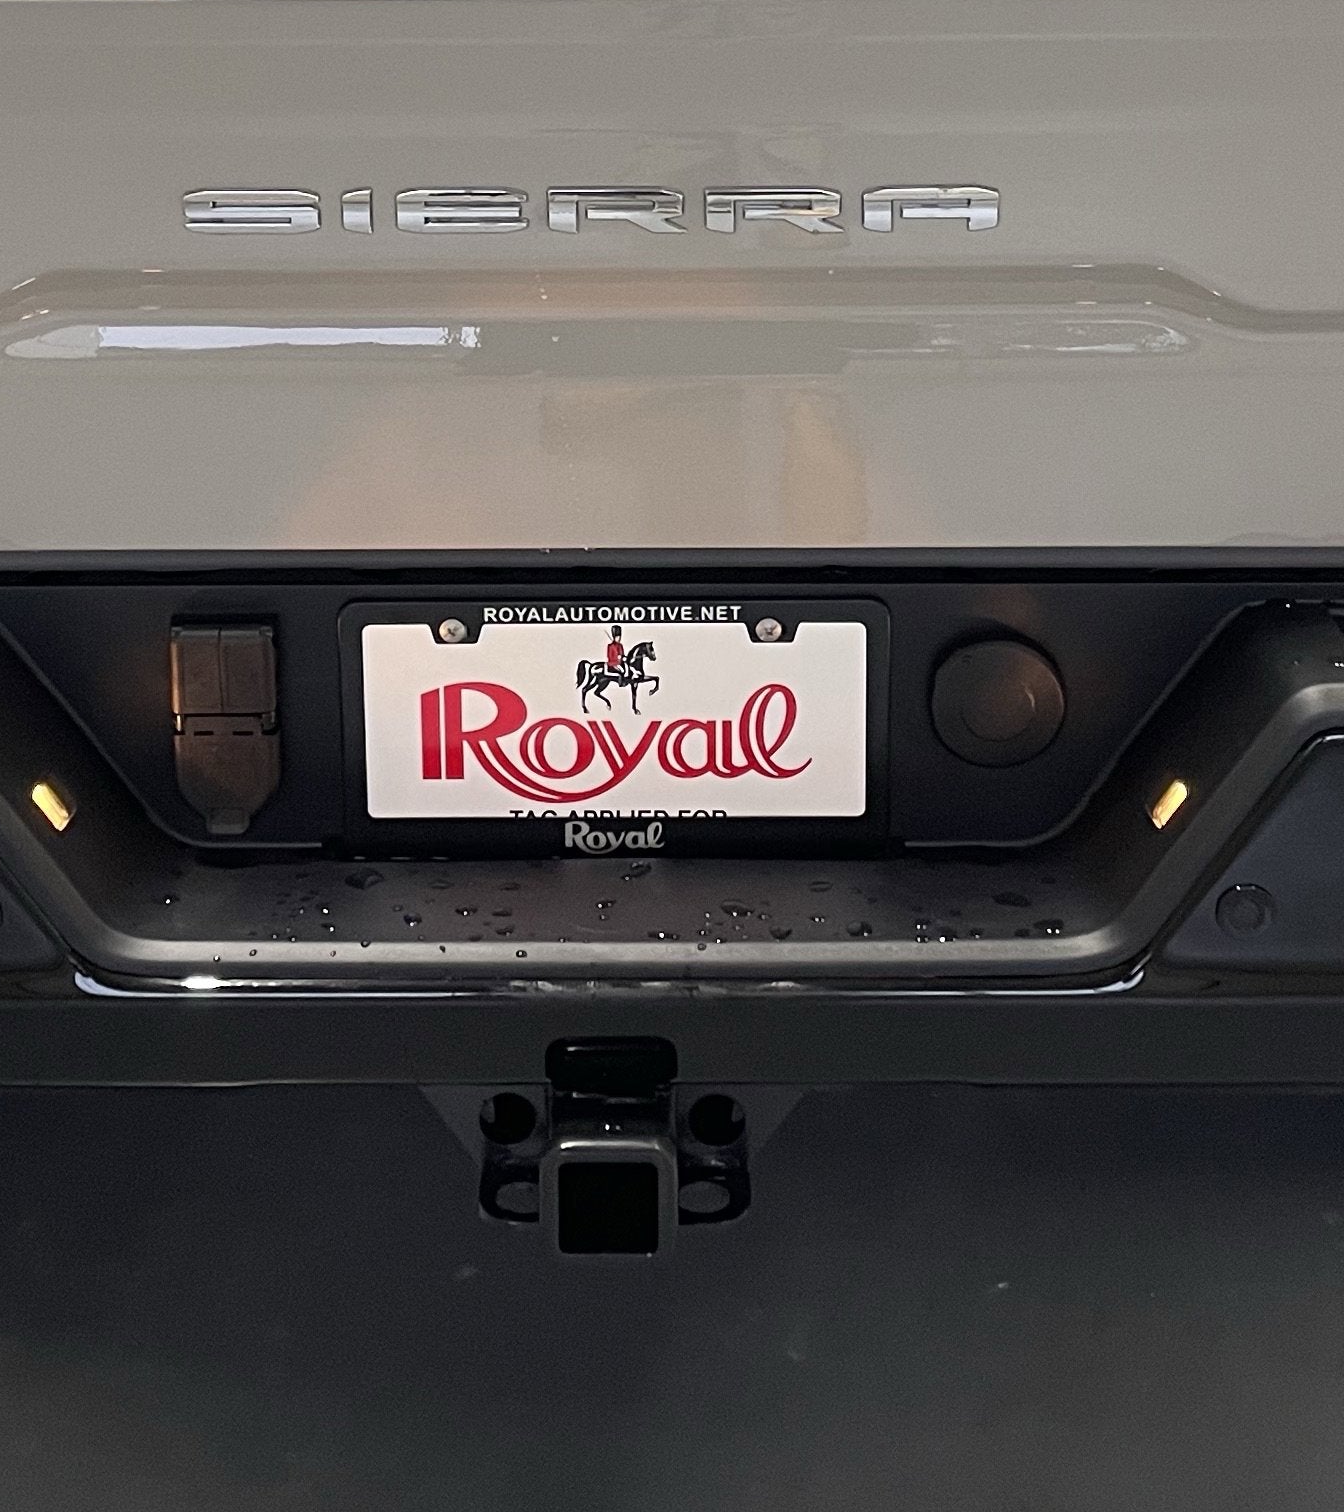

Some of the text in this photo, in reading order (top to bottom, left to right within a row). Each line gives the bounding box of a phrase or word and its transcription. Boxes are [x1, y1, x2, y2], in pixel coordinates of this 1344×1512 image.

[182, 185, 1000, 234] SIERRA
[484, 605, 742, 622] ROYALAUTOMOTIVE.NET
[420, 681, 813, 804] Royal
[564, 820, 666, 855] Royal
